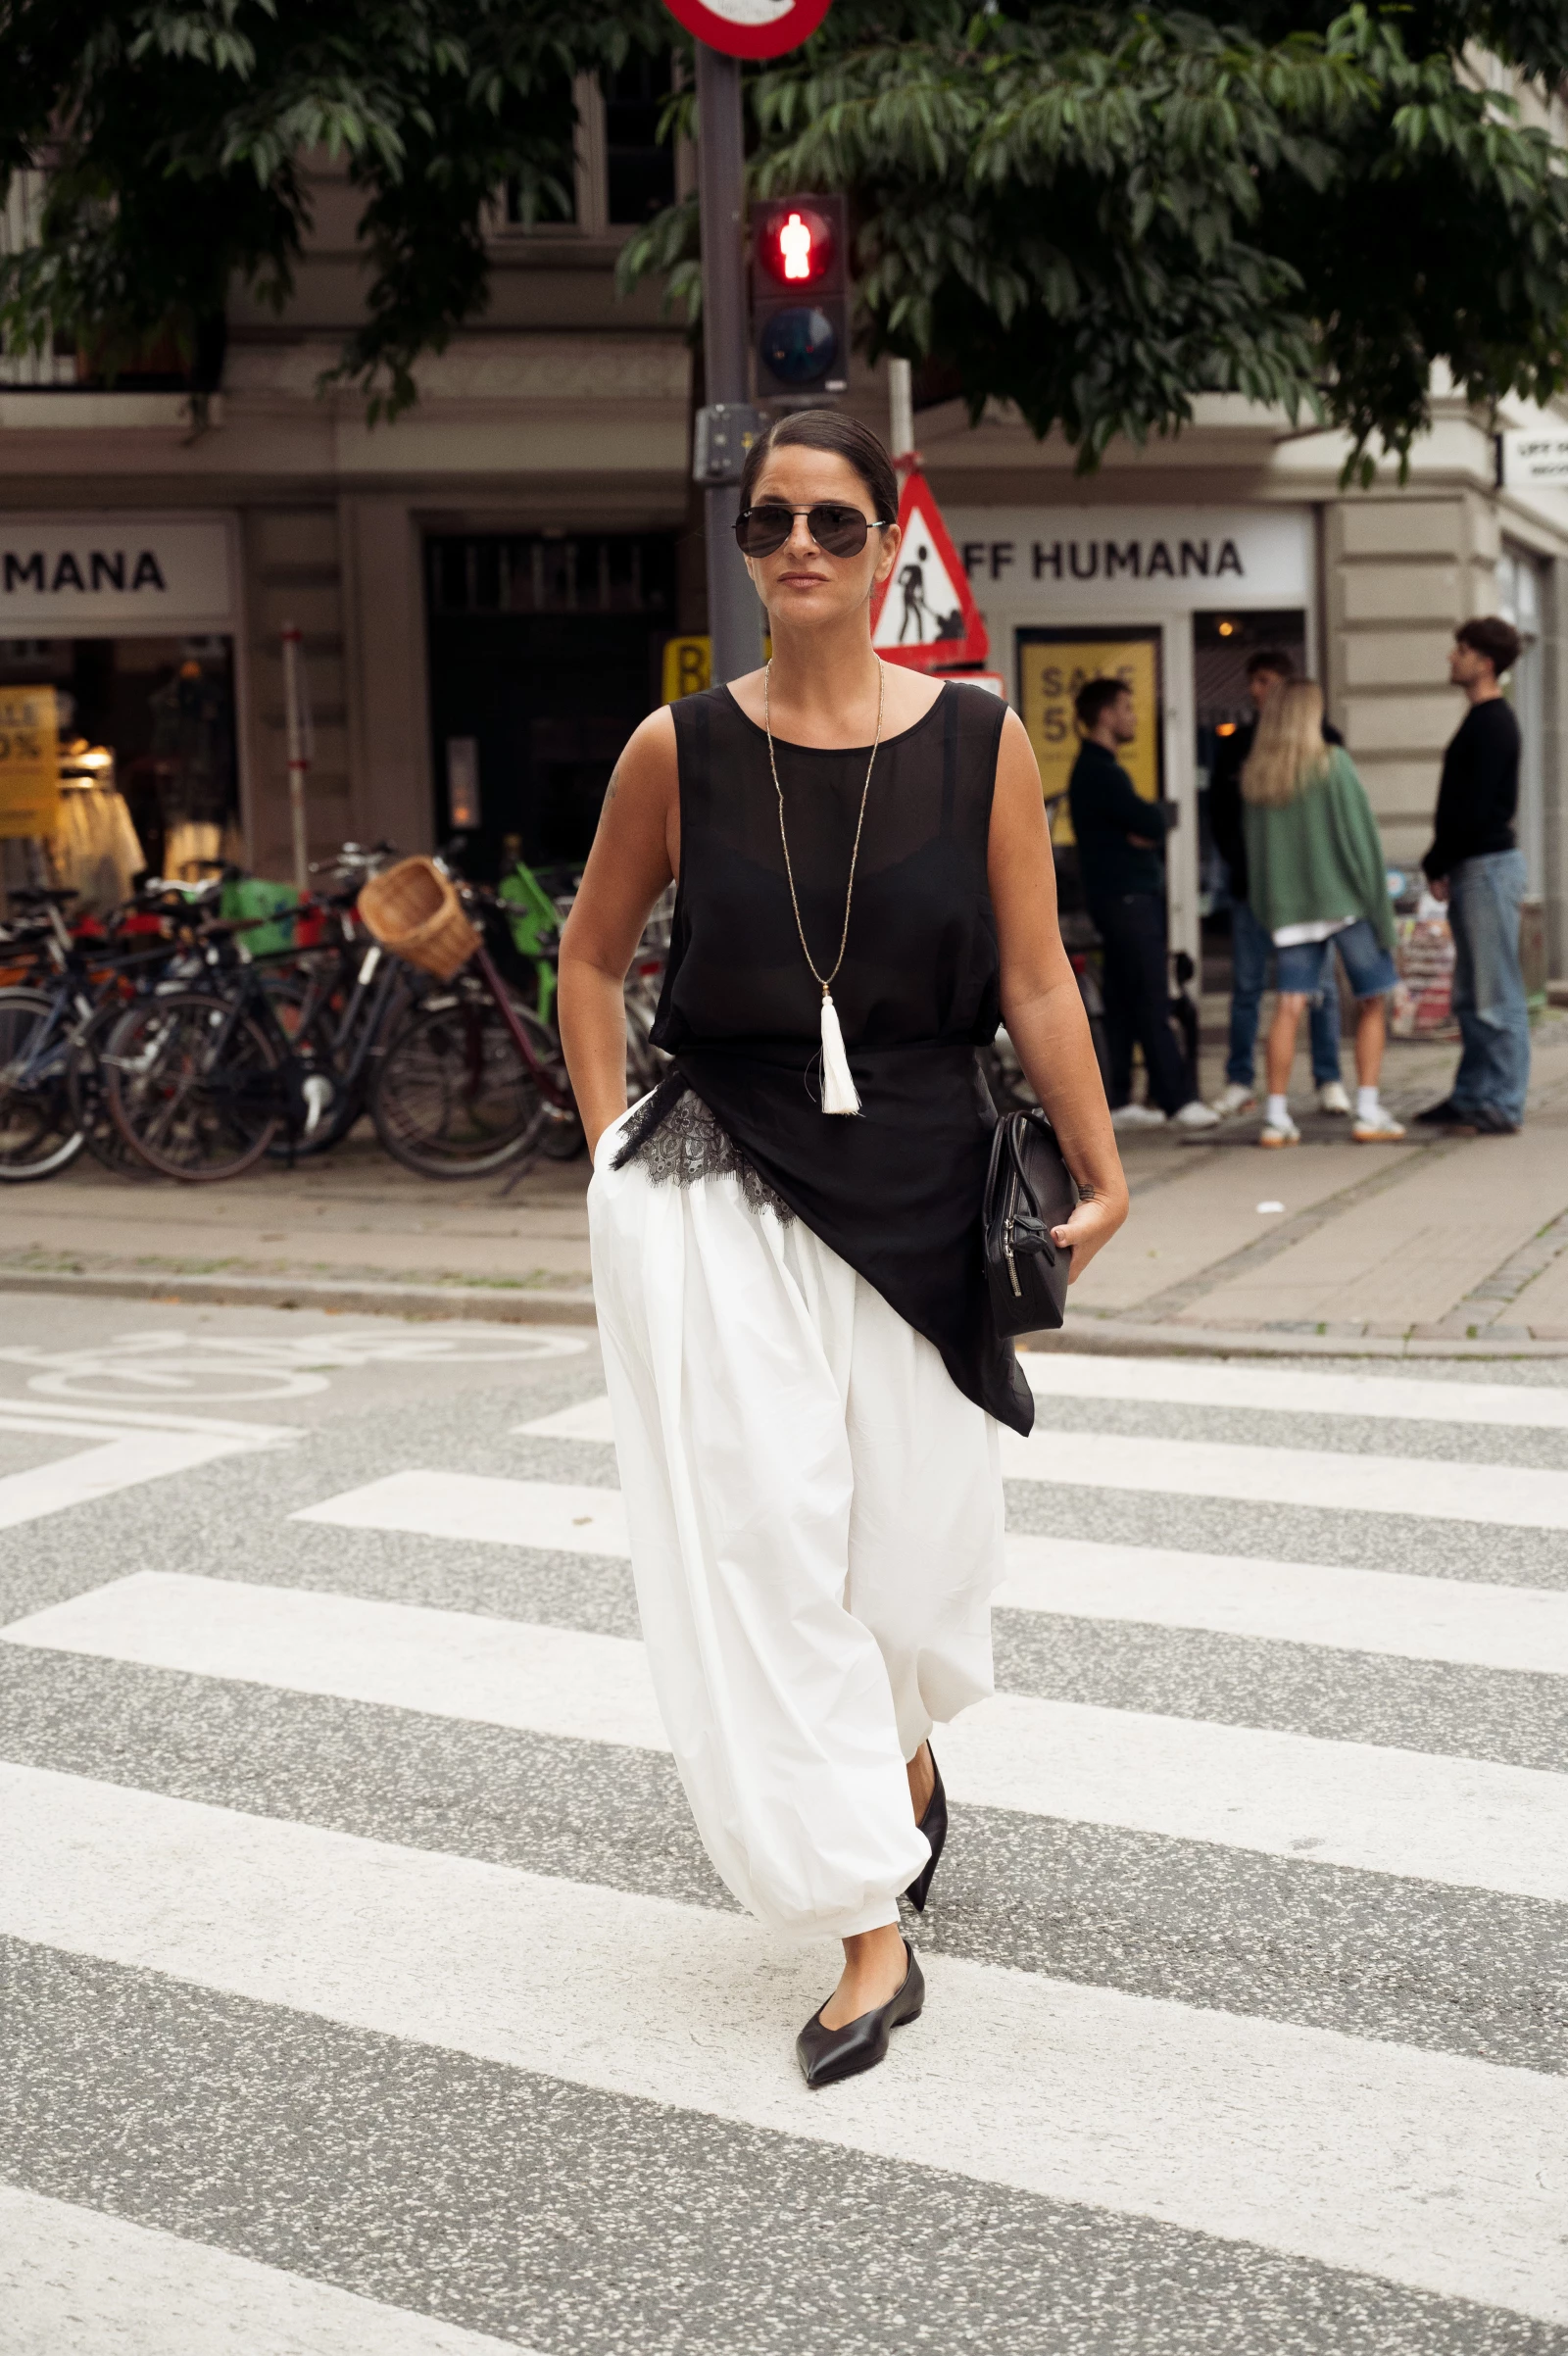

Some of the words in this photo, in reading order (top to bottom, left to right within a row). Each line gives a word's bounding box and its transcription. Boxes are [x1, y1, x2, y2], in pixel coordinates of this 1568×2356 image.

[4, 551, 166, 592] MANA
[1032, 540, 1244, 580] HUMANA
[1041, 665, 1135, 699] SA
